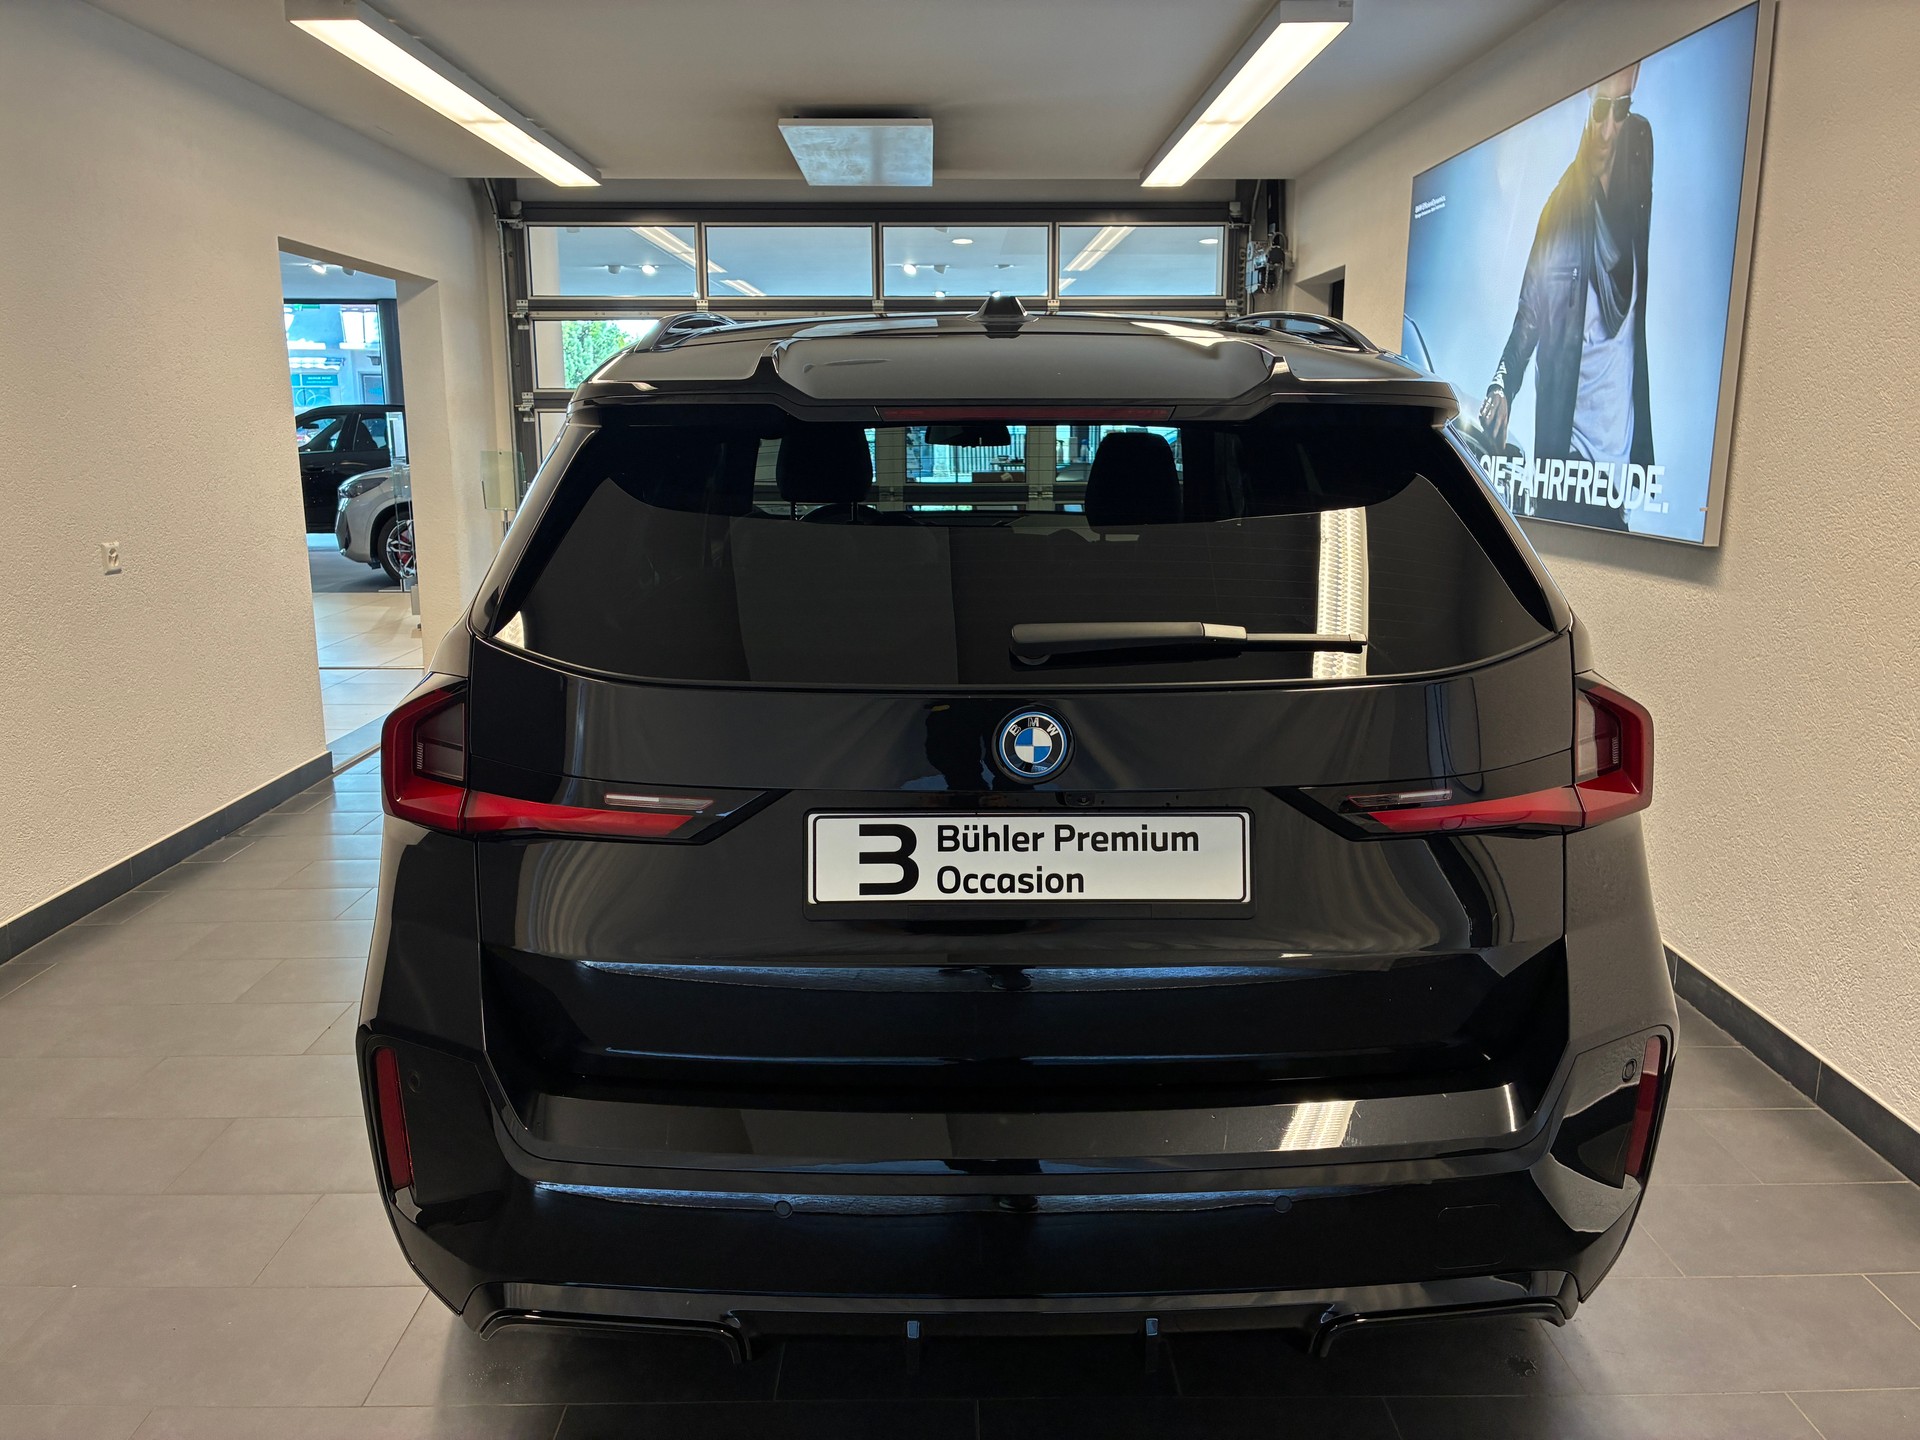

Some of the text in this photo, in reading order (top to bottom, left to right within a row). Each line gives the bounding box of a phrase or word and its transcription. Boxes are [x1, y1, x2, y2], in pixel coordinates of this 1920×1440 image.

[1510, 456, 1669, 514] FAHRFREUDE.
[1009, 716, 1059, 737] BMW
[937, 824, 1199, 853] Bühler Premium
[936, 865, 1084, 894] Occasion
